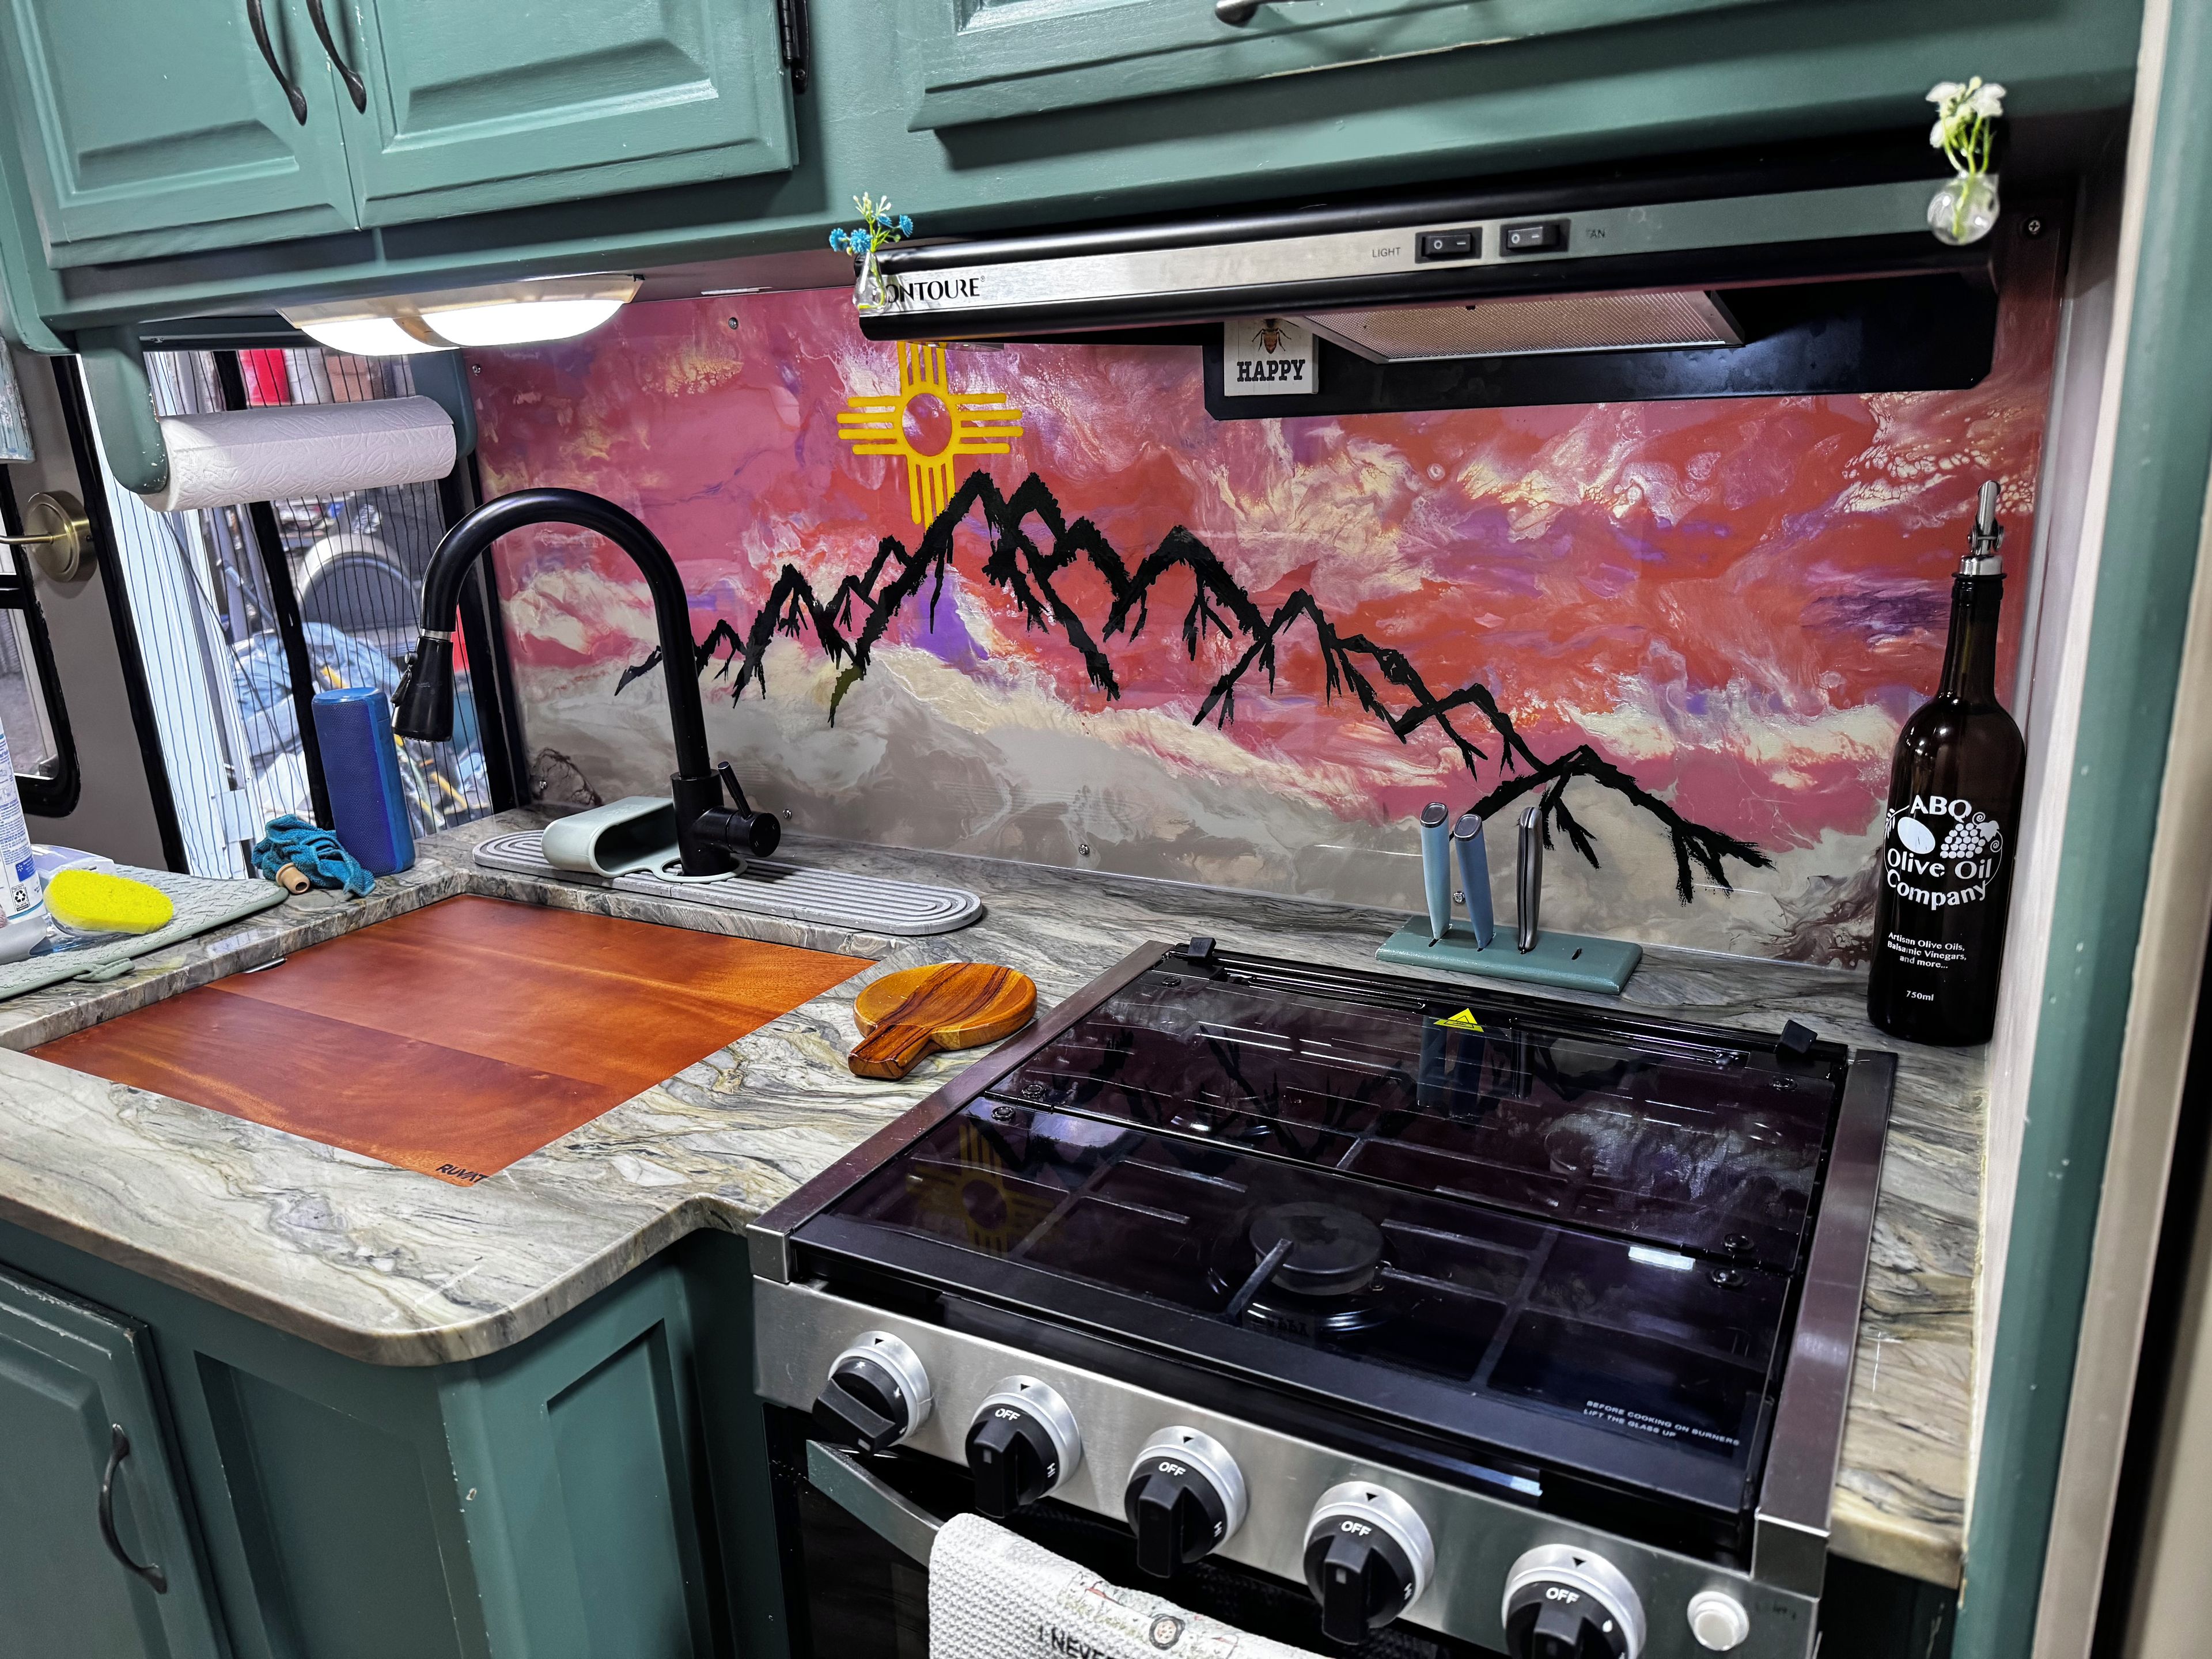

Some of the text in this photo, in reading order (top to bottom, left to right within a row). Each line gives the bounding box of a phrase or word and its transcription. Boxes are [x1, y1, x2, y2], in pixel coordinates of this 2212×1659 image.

[1372, 247, 1401, 257] LIGHT
[873, 278, 980, 303] ONTOURE
[1237, 359, 1305, 382] HAPPY
[1910, 795, 1972, 823] ABQ
[1888, 849, 1992, 879] Olive Oil
[1887, 869, 1986, 910] Company
[1888, 932, 1965, 952] Artisan Olive Oils,
[1888, 941, 1967, 961] Balsamic Vinegars,
[1900, 956, 1915, 964] and
[1906, 990, 1934, 1001] 750ml
[435, 1164, 490, 1183] RUVAT
[995, 1408, 1021, 1421] OFF
[1584, 1409, 1604, 1418] LIFT
[1607, 1414, 1626, 1424] THE
[1627, 1421, 1660, 1433] GLASS
[1586, 1400, 1740, 1446] BEFORE COOKING ON BURNERS
[1158, 1461, 1186, 1476] OFF
[1341, 1521, 1372, 1536] OFF
[1546, 1587, 1580, 1604] OFF
[1051, 1626, 1115, 1659] NEVE
